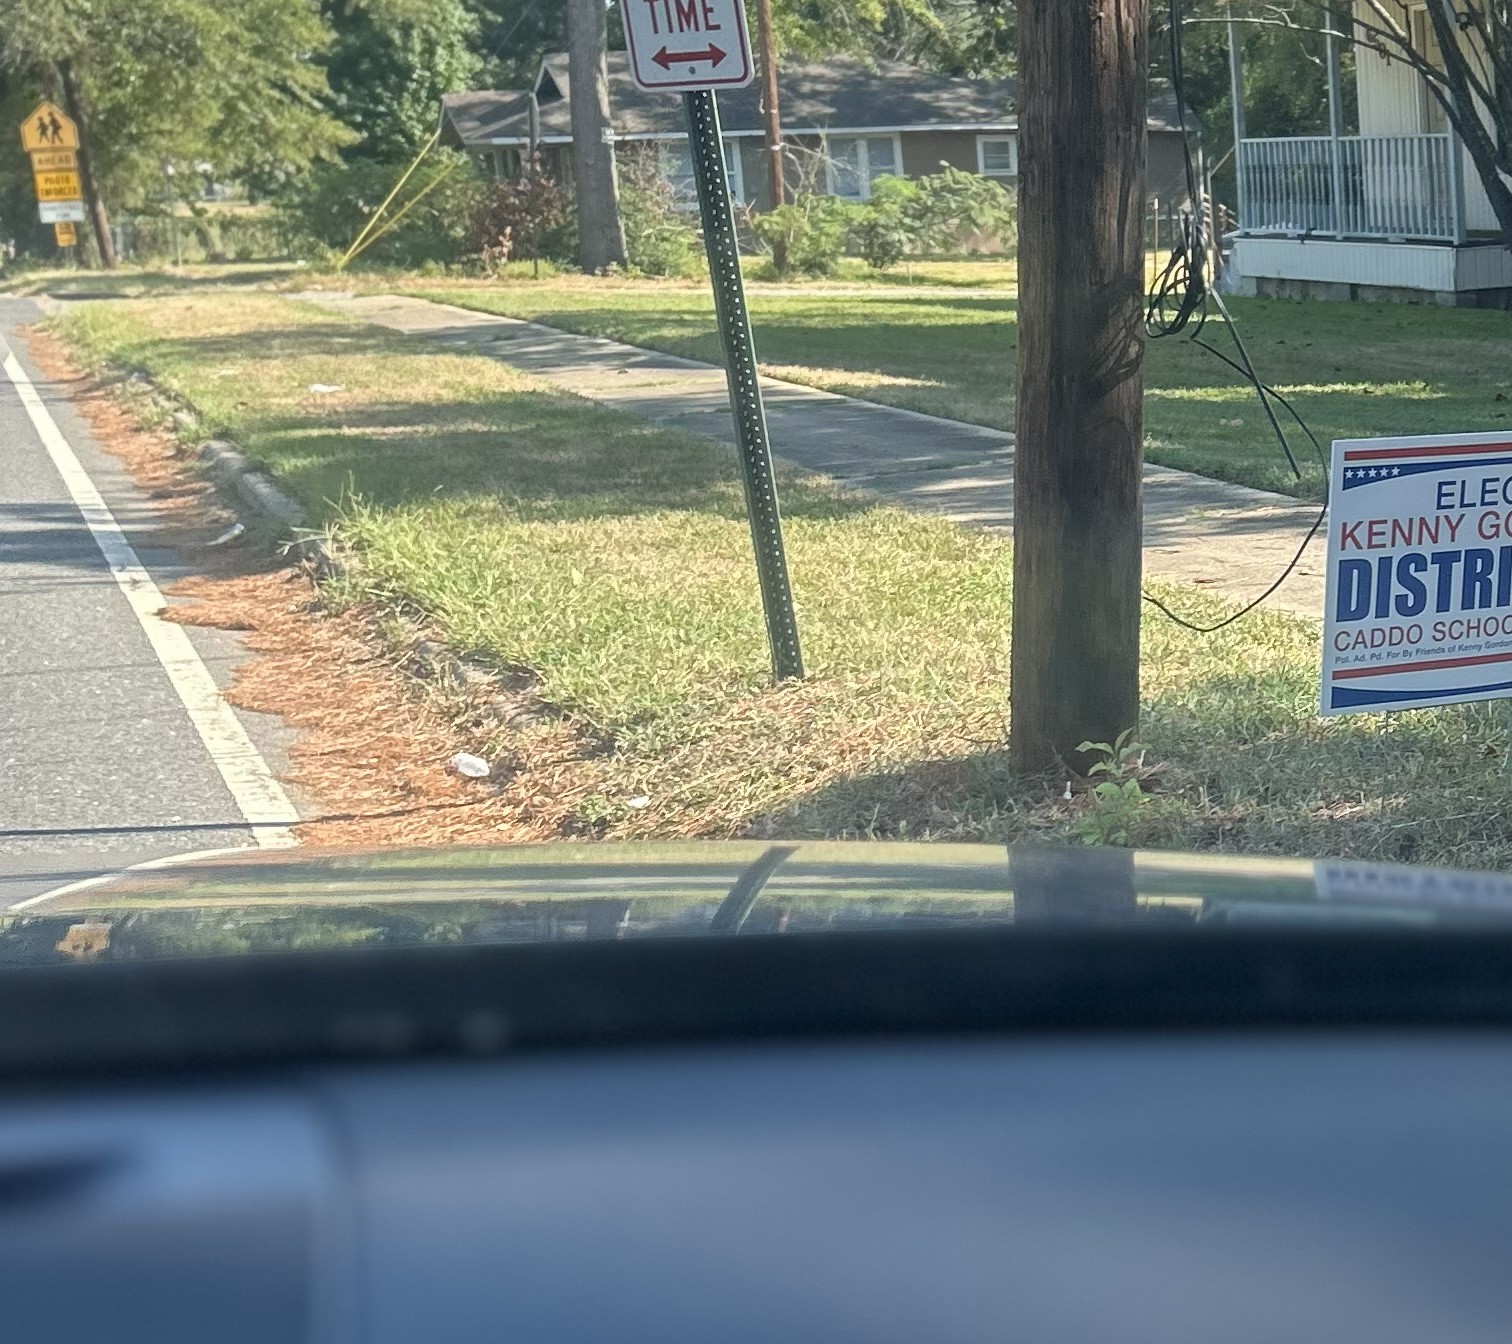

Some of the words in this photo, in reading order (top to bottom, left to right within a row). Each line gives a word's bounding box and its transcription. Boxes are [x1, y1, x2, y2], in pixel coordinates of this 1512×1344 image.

[37, 154, 71, 166] AHEAD
[1340, 513, 1465, 551] KENNY
[1334, 623, 1423, 652] CADDO
[1402, 649, 1413, 658] By
[1415, 646, 1446, 656] Friends
[1448, 644, 1456, 653] of
[1459, 641, 1483, 652] Kenny
[1484, 639, 1512, 649] Gordon
